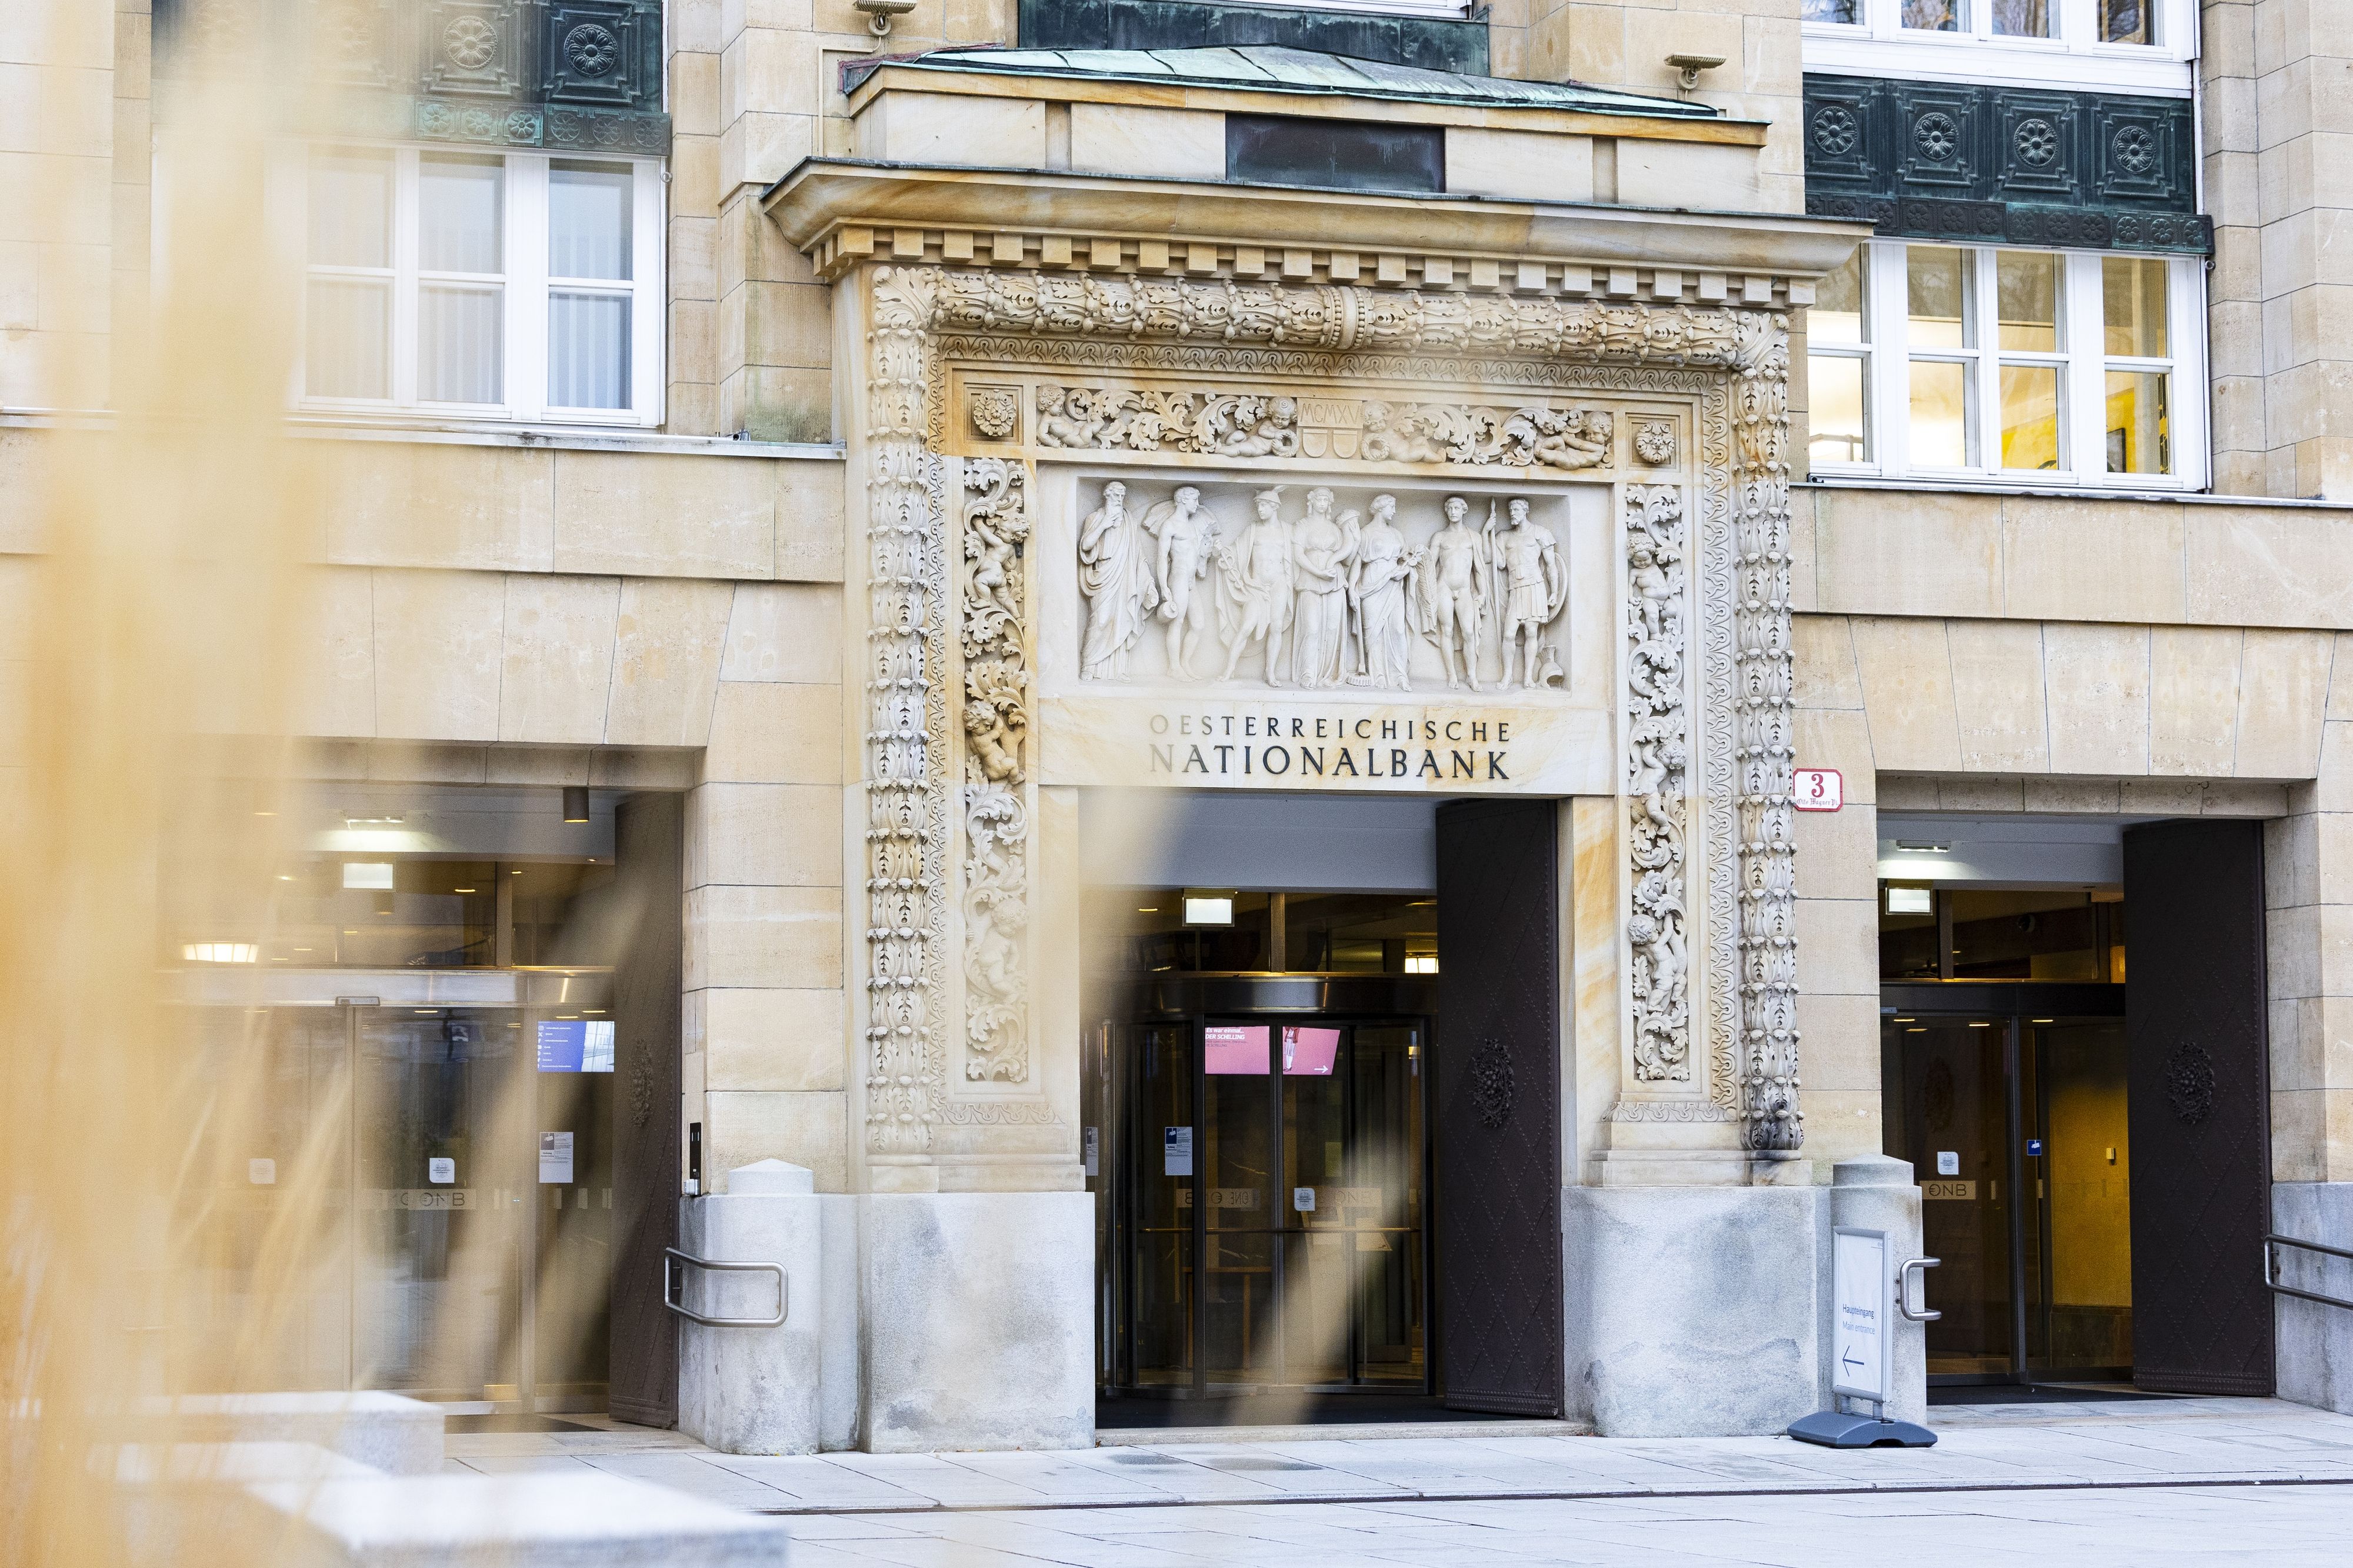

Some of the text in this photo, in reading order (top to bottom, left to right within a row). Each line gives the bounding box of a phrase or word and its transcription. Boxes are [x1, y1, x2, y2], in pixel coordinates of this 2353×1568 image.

[1149, 714, 1510, 742] OESTERREICHISCHE
[1149, 744, 1510, 780] NATIONALBANK
[1811, 773, 1825, 798] 3
[1810, 798, 1831, 806] Wagner
[1842, 1303, 1874, 1320] Haupteingang
[1842, 1320, 1875, 1335] Main entrance
